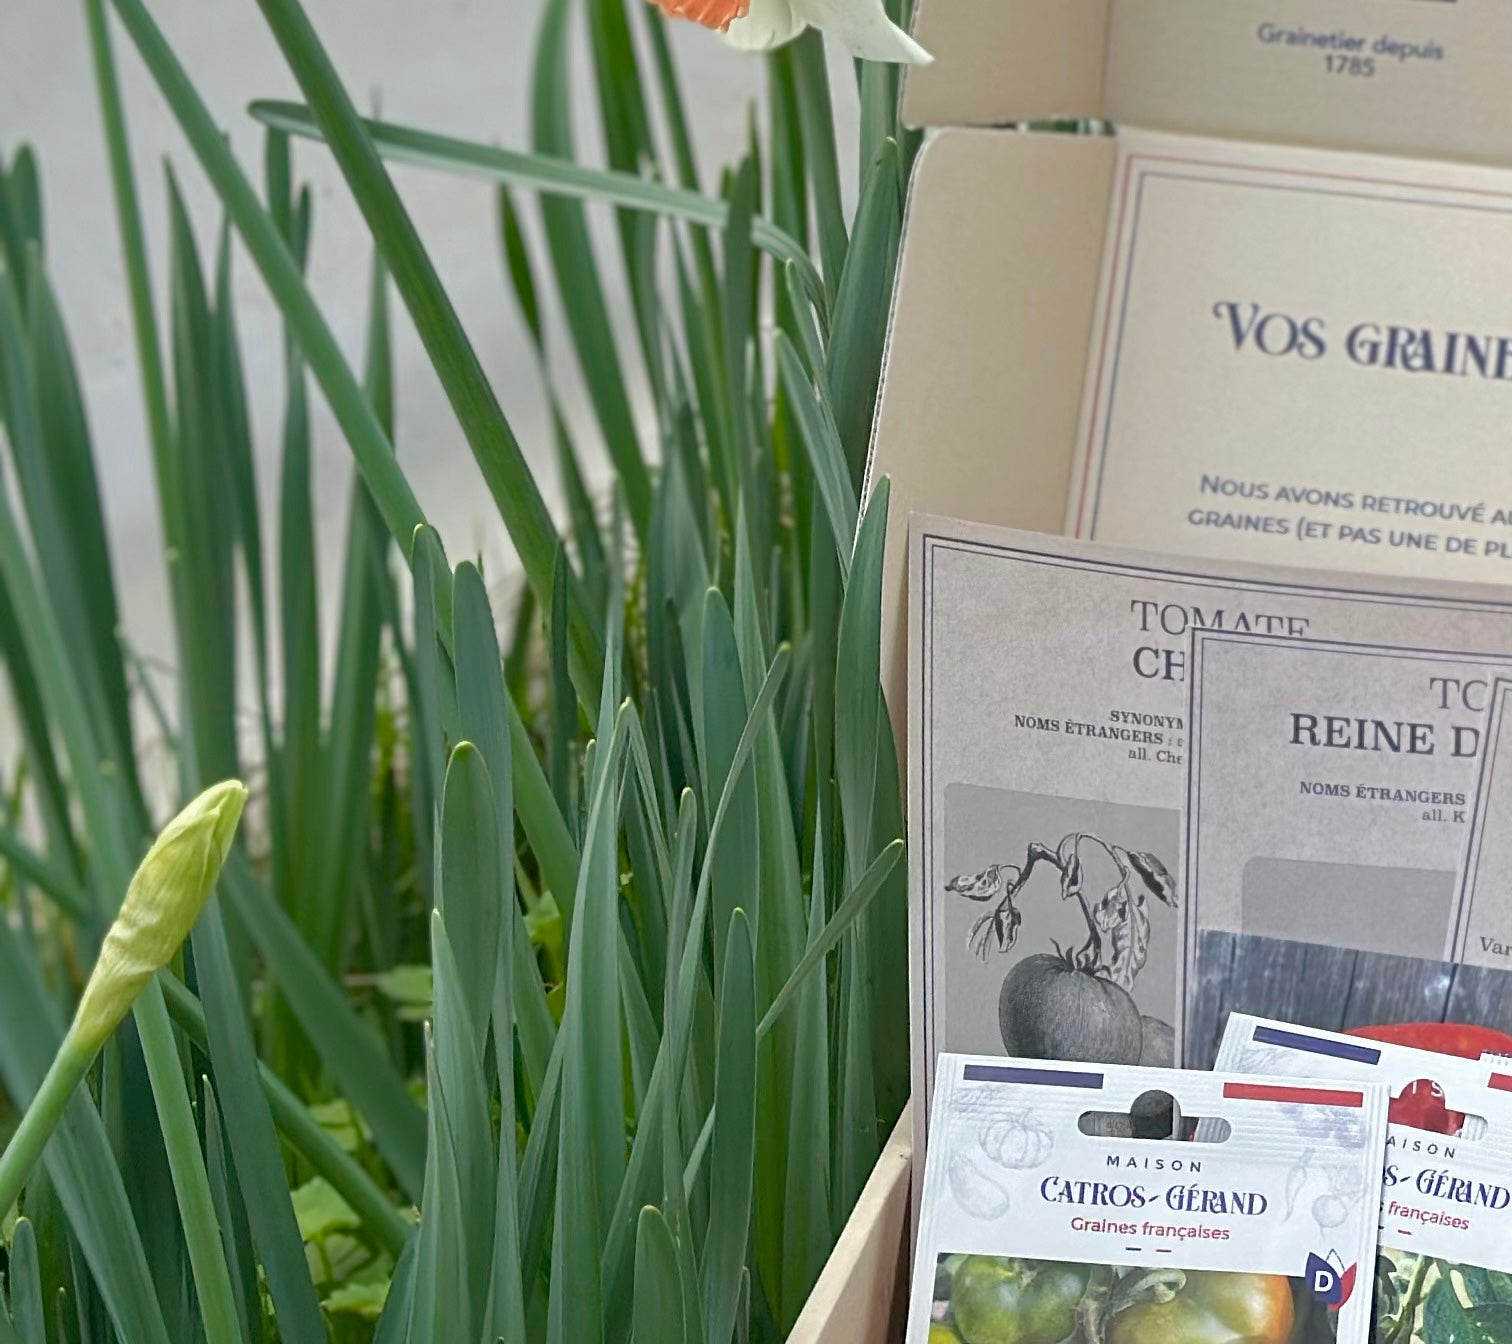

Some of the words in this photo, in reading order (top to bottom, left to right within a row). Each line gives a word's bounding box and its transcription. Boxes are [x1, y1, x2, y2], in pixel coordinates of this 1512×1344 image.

[1258, 23, 1366, 51] Grainetier
[1372, 35, 1444, 62] depuis
[1326, 55, 1374, 76] 1785
[1213, 303, 1326, 357] VOS
[1200, 474, 1269, 500] NOUS
[1274, 486, 1354, 509] AVONS
[1361, 495, 1485, 523] RETROUVÉ
[1187, 509, 1289, 535] GRAINES
[1297, 516, 1333, 541] (ET
[1338, 525, 1381, 544] PAS
[1389, 530, 1438, 551] UNE
[1445, 536, 1477, 555] DE
[1015, 714, 1060, 732] NOMS
[1065, 719, 1163, 744] ÉTRANGERS
[1290, 713, 1434, 756] REINE
[1300, 781, 1350, 797] NOMS
[1356, 784, 1466, 806] ÉTRANGERS
[1107, 1155, 1201, 1173] MAISON
[1383, 1164, 1511, 1210] S-GÉRAND
[1071, 1217, 1137, 1235] Graines
[1142, 1221, 1230, 1241] françaises
[1388, 1201, 1470, 1230] françaises
[1314, 1269, 1333, 1293] D
